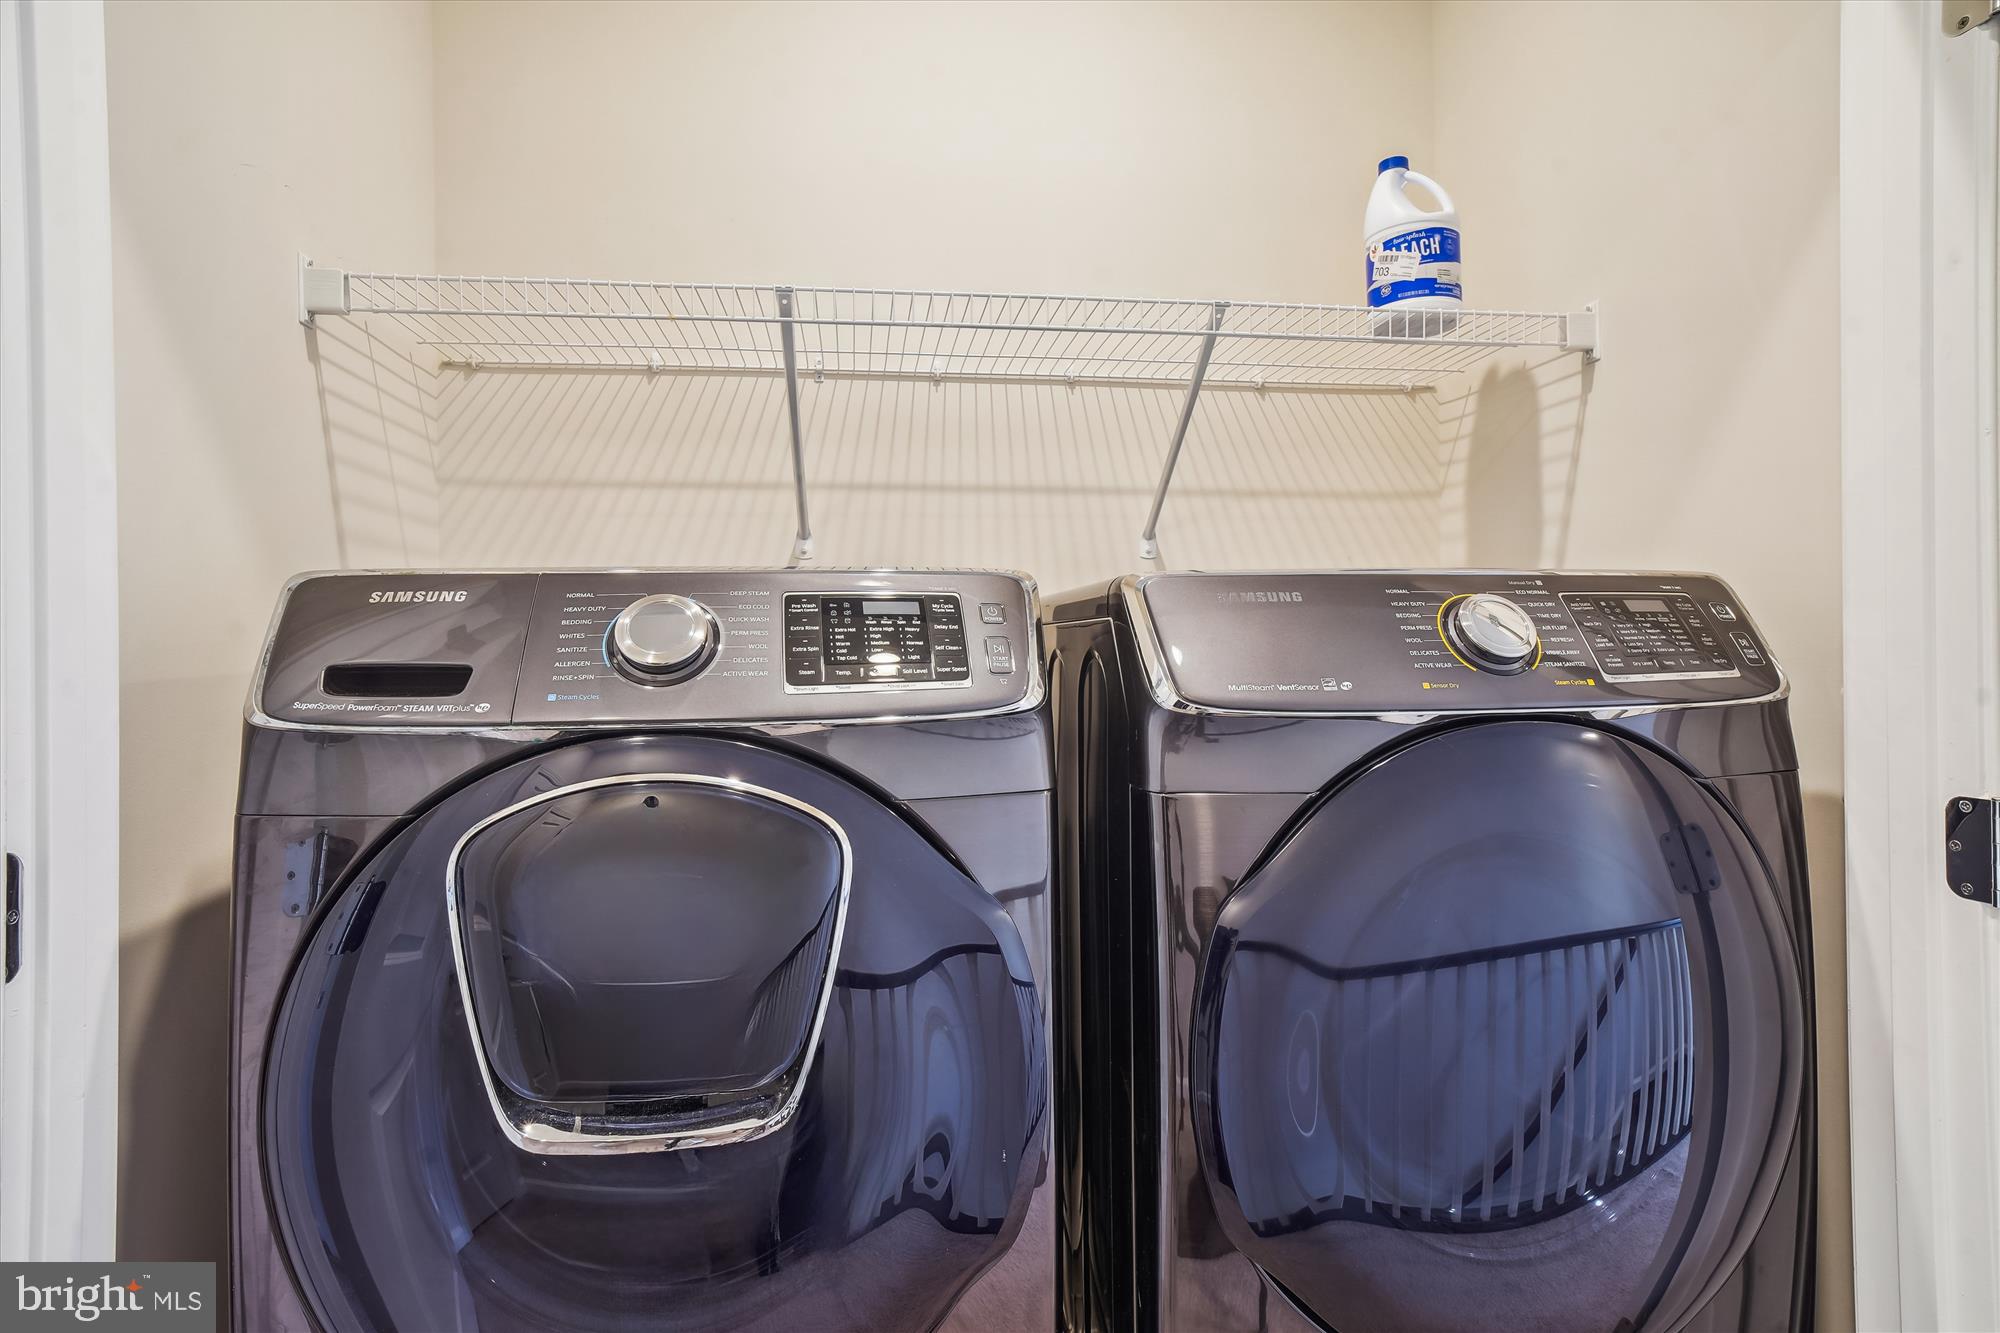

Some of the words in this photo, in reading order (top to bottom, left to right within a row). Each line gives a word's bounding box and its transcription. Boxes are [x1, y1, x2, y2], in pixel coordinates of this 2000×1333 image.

[1375, 267, 1390, 277] 703
[369, 590, 468, 603] SAMSUNG
[1217, 591, 1303, 602] SAMSUNG
[292, 701, 345, 712] SuperSpeed
[402, 704, 434, 712] STEAM
